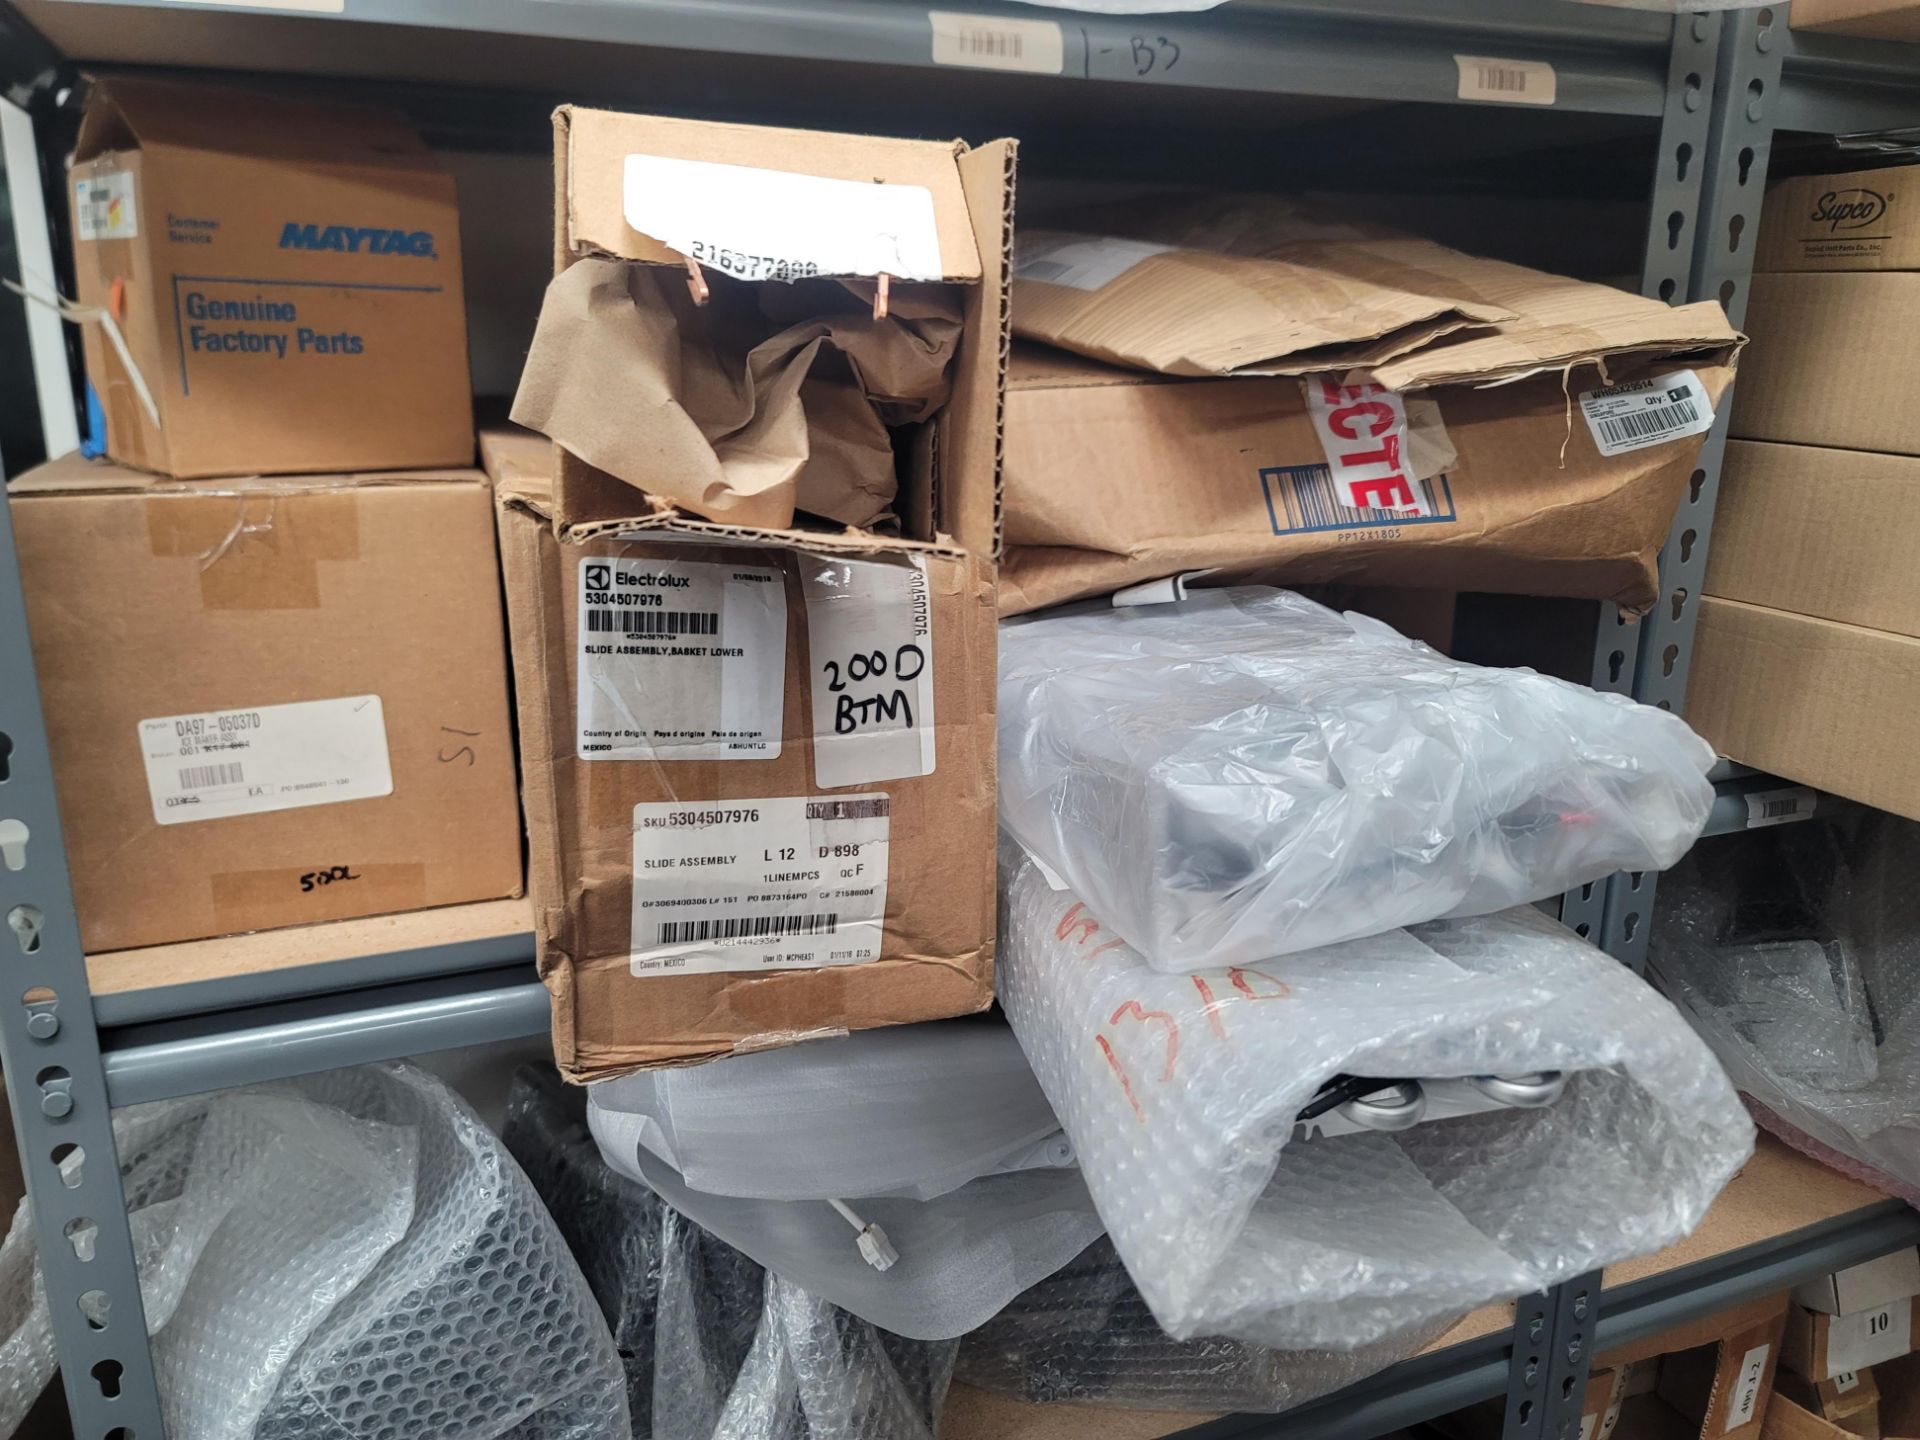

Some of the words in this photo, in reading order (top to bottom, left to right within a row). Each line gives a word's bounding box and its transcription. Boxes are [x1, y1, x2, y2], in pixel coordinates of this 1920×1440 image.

[1811, 191, 1875, 232] Supco
[169, 231, 212, 246] Service
[280, 222, 435, 259] MAYTAG
[186, 293, 297, 323] Genuine
[191, 326, 287, 359] Factory
[299, 328, 365, 356] Parts
[1644, 394, 1667, 406] Qty:
[1338, 529, 1402, 542] PP12X1805
[616, 571, 690, 589] Electrolux
[909, 571, 928, 637] 304507976
[585, 645, 613, 654] SLIDE
[711, 647, 744, 657] LOWER
[835, 689, 914, 734] BTM
[583, 730, 612, 738] Country
[624, 730, 647, 739] Origin
[644, 817, 666, 828] SKU
[669, 809, 759, 826] 5304507976
[808, 803, 825, 819] QTY
[764, 849, 772, 861] L
[779, 848, 795, 860] 12
[819, 846, 829, 858] D
[835, 844, 859, 857] 898
[644, 858, 676, 868] SLIDE
[680, 856, 736, 867] ASSEMBLY
[840, 869, 854, 878] QC
[856, 863, 864, 875] F
[723, 896, 738, 904] 151
[664, 959, 685, 968] MEXICO
[1869, 1312, 1888, 1335] 10
